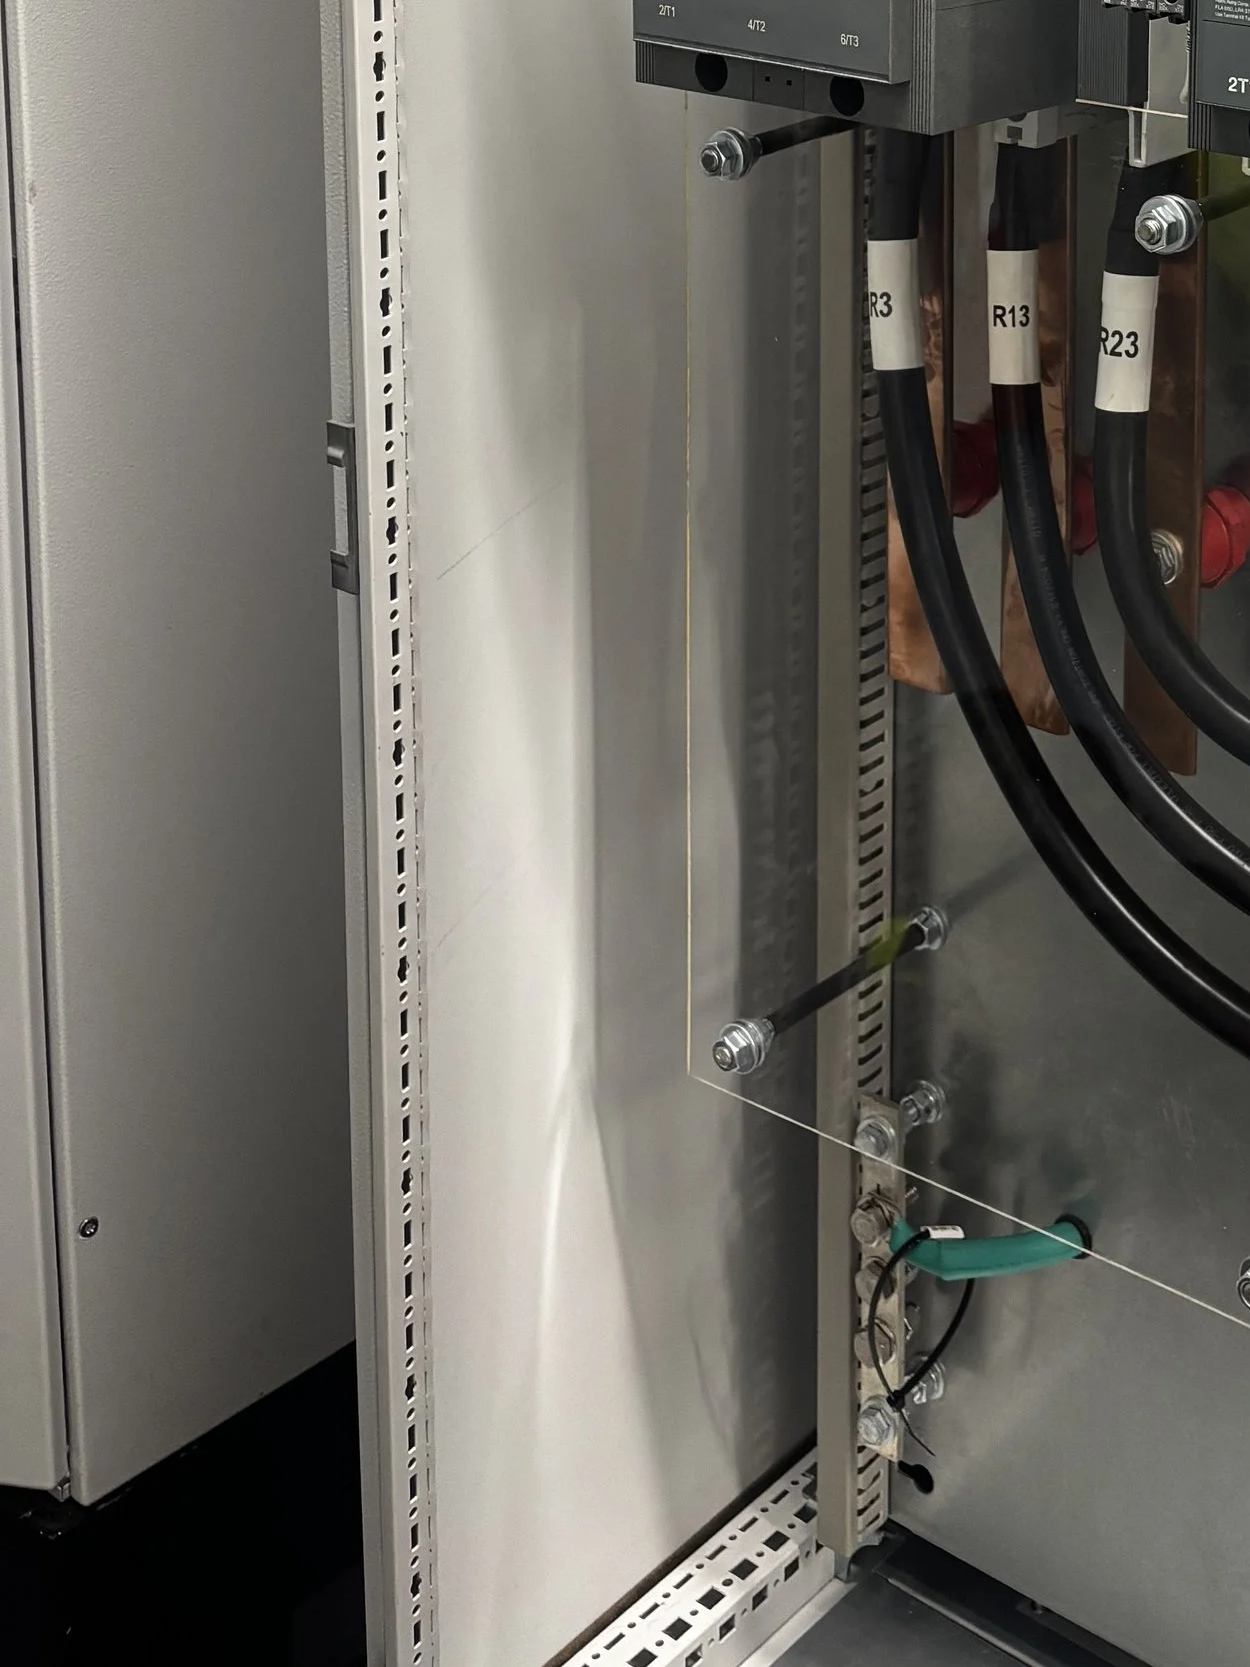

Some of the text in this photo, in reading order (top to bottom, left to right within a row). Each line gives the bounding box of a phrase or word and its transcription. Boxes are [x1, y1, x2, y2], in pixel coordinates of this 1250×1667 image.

[658, 4, 675, 18] 2/T1
[747, 19, 766, 33] 4/T2
[840, 33, 859, 47] 6/T3
[870, 291, 893, 318] R3
[992, 304, 1030, 328] R13
[1100, 326, 1139, 359] R23
